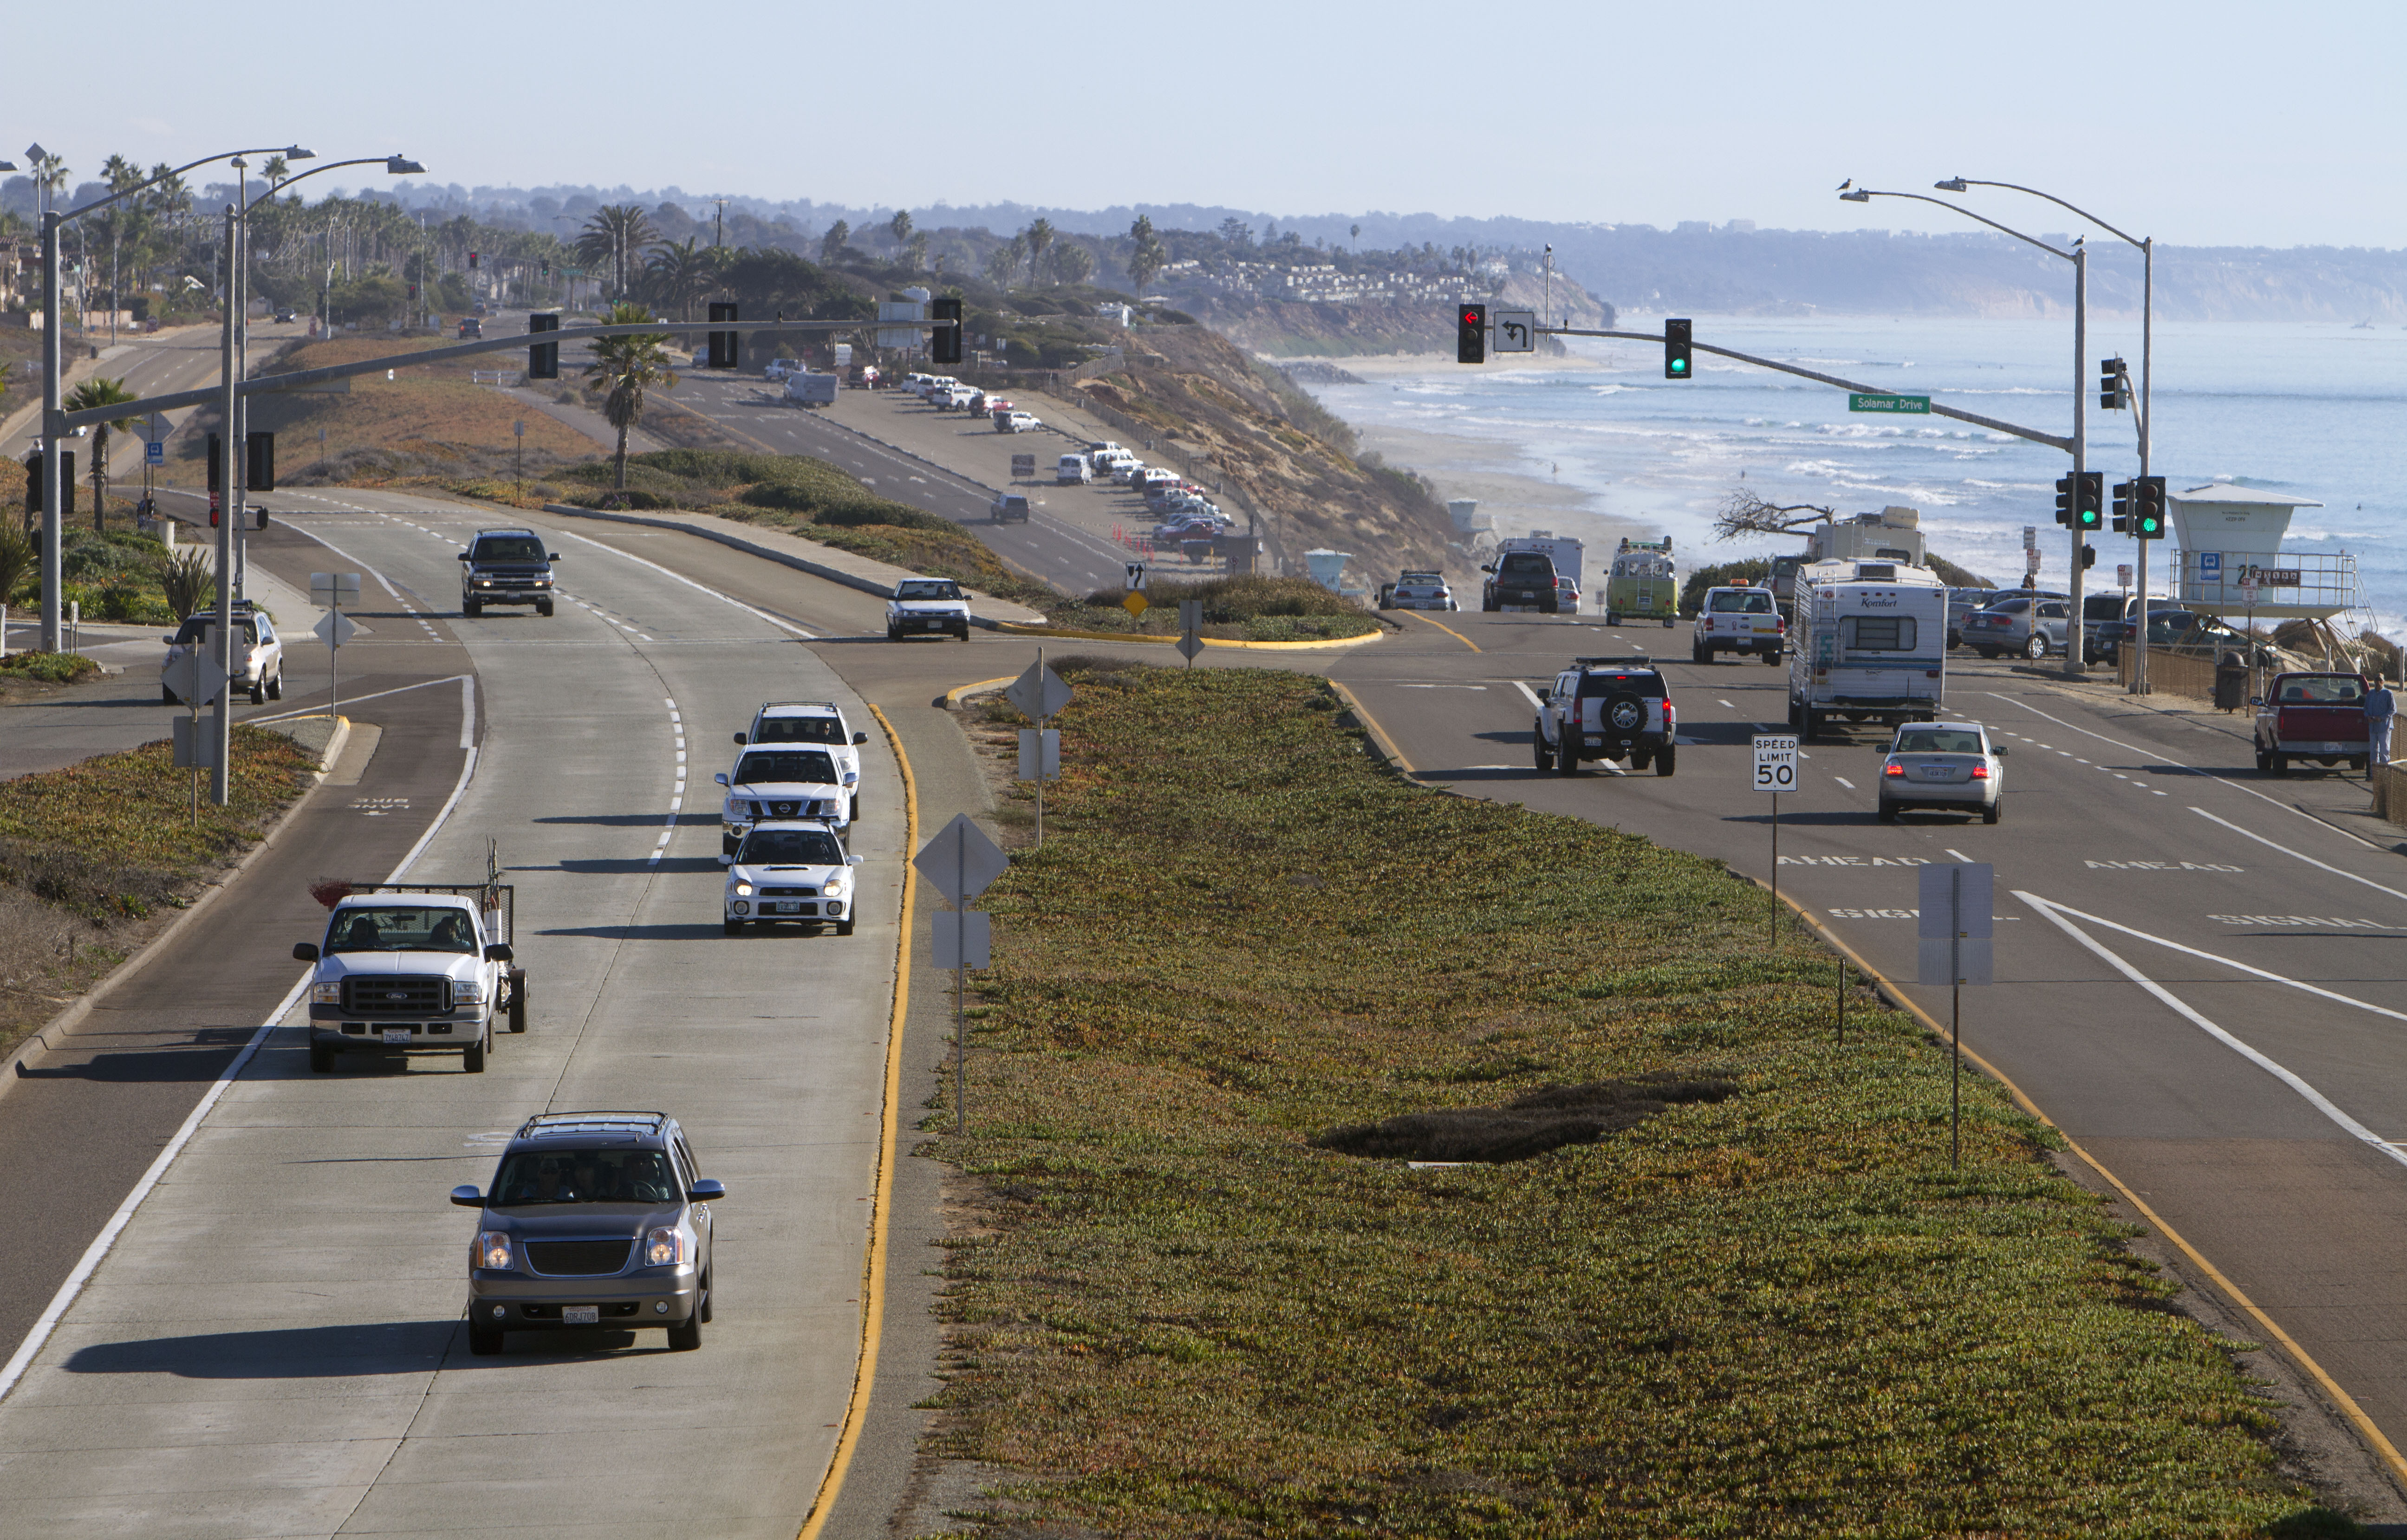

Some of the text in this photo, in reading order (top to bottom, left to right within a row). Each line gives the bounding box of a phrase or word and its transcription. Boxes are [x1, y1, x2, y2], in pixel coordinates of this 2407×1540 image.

[1858, 397, 1923, 410] Solamar Drive
[1861, 598, 1897, 608] Komfort
[1756, 740, 1795, 749] SPEED
[1759, 753, 1791, 762] LIMIT
[1757, 764, 1793, 785] 50
[1777, 856, 1932, 866] AHEAD
[2083, 860, 2244, 872] AHEAD
[2205, 915, 2407, 930] SIGNAL
[565, 1312, 596, 1321] 6DRJ708
